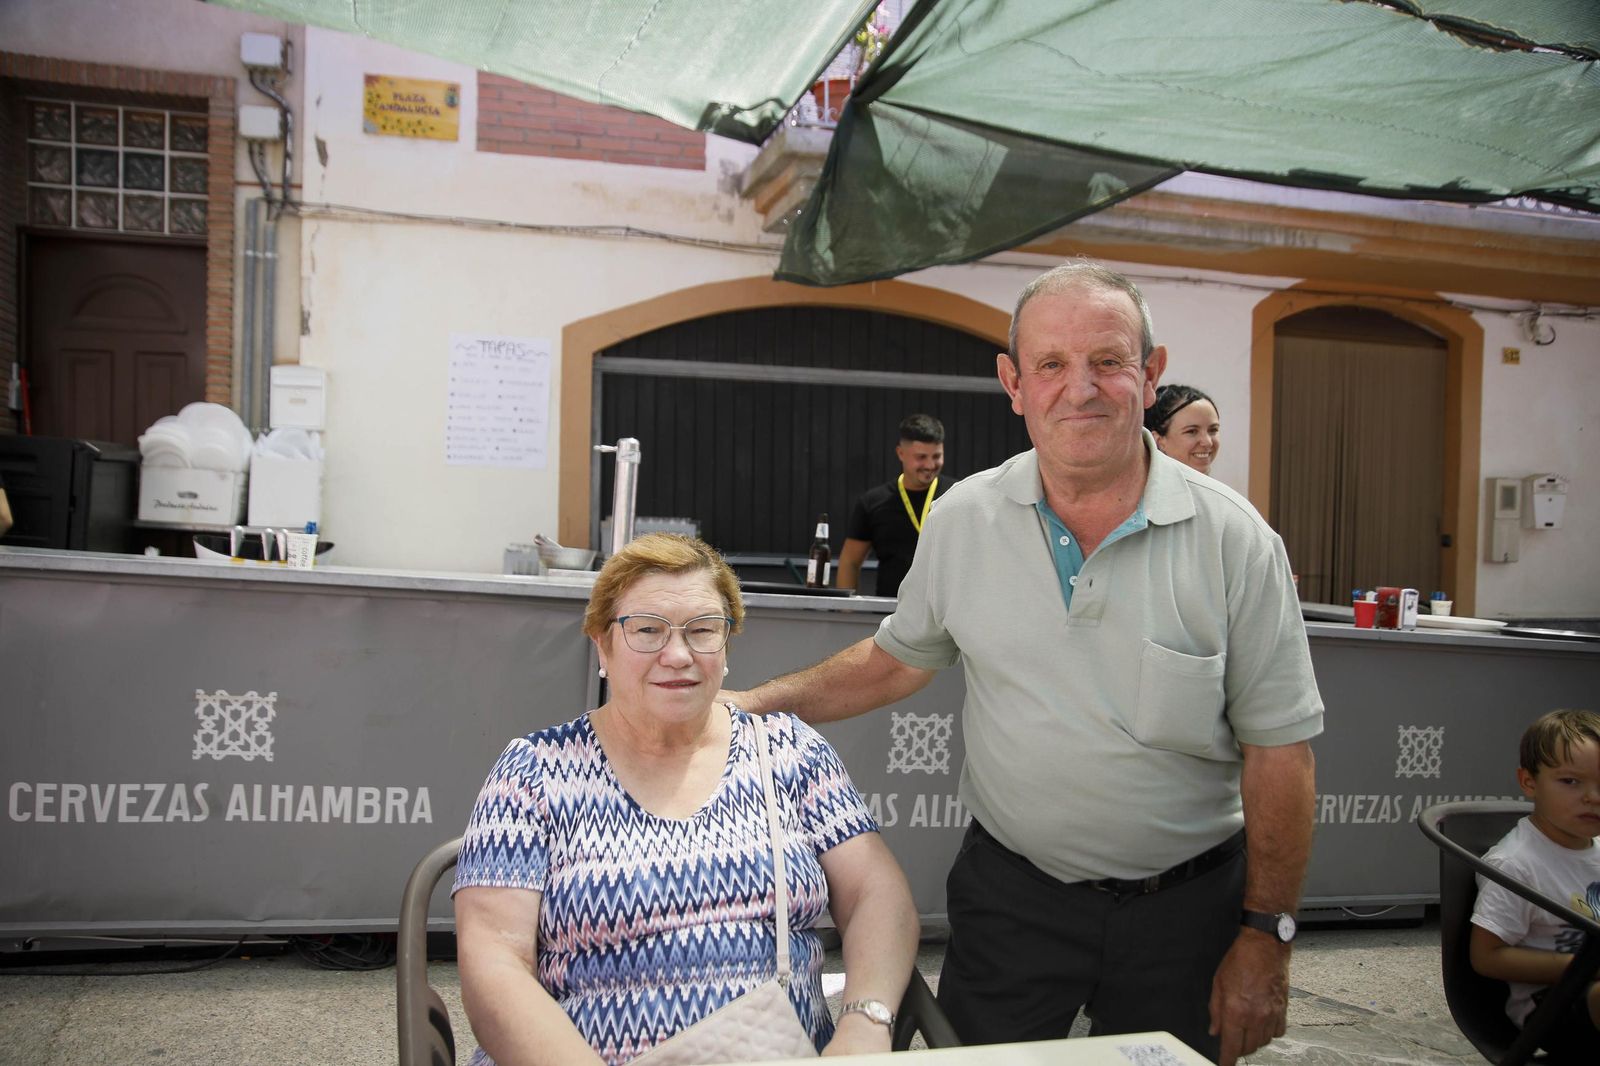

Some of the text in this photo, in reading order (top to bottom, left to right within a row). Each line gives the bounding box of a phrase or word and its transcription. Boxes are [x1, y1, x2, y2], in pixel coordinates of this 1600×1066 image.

[392, 92, 426, 103] PLAZA
[475, 339, 527, 357] TAPAS
[8, 782, 433, 824] CERVEZAS ALHAMBRA
